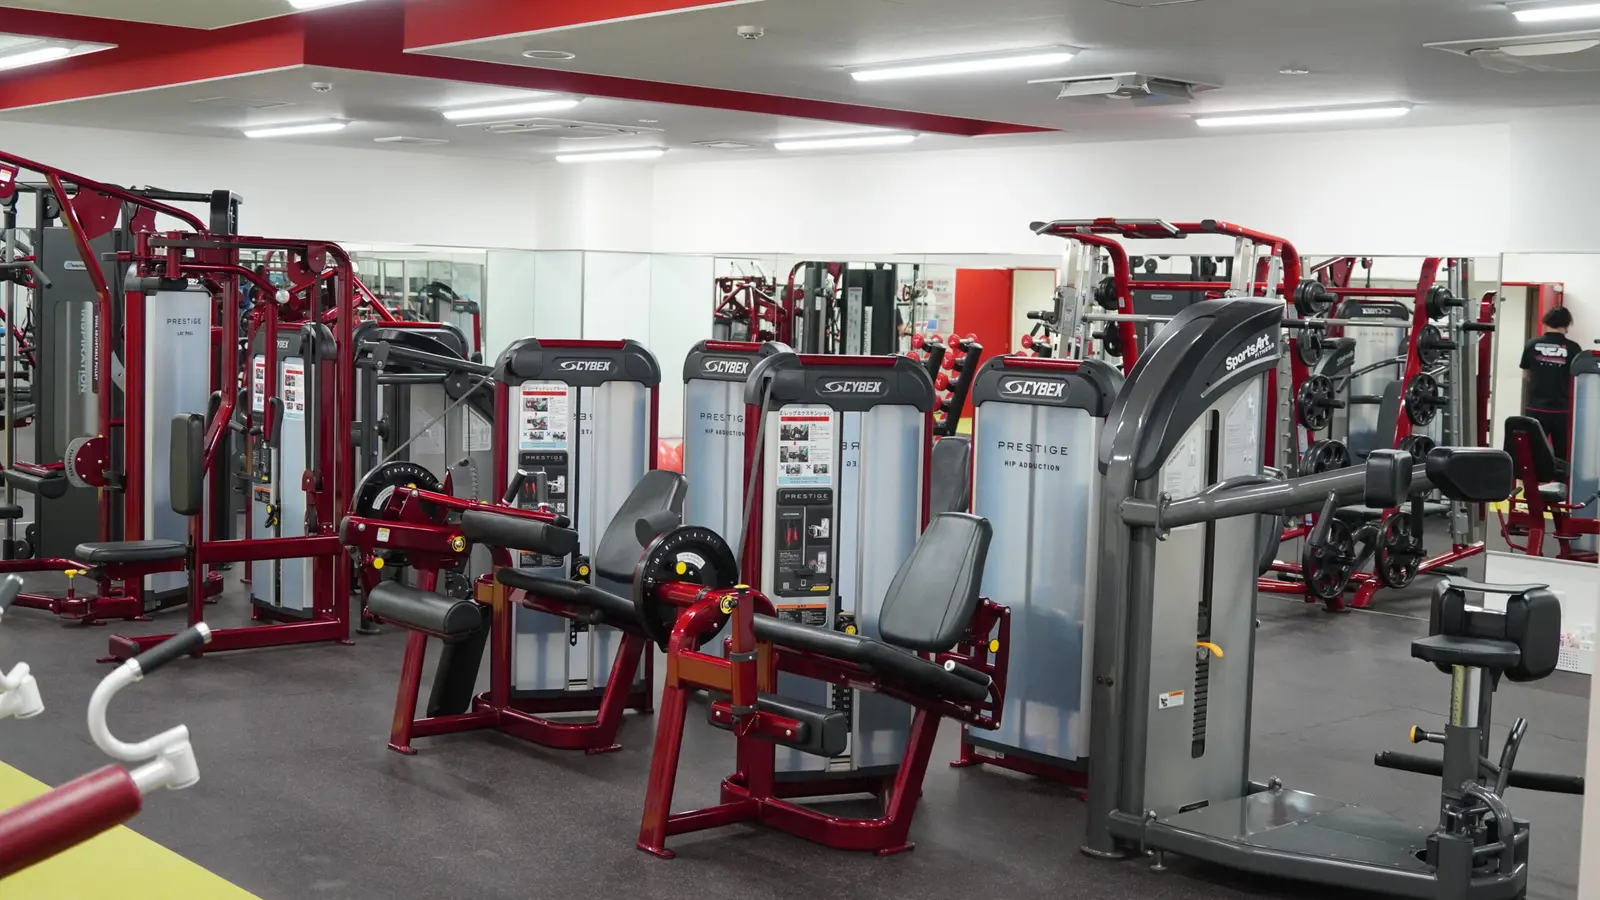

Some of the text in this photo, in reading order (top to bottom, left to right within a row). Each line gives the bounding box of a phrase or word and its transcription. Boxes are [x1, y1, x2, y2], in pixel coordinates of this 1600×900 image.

[166, 317, 202, 325] PRESTIGE
[1225, 333, 1270, 370] SportsArt
[1254, 342, 1275, 359] FITNESS
[575, 361, 612, 371] CYBEX
[716, 361, 749, 374] CYBEX
[842, 381, 883, 393] CYBEX
[1021, 381, 1066, 397] CYBEX
[699, 412, 744, 423] PRESTIG
[997, 441, 1069, 456] PRESTIGE
[1018, 461, 1061, 472] ADDUCTION
